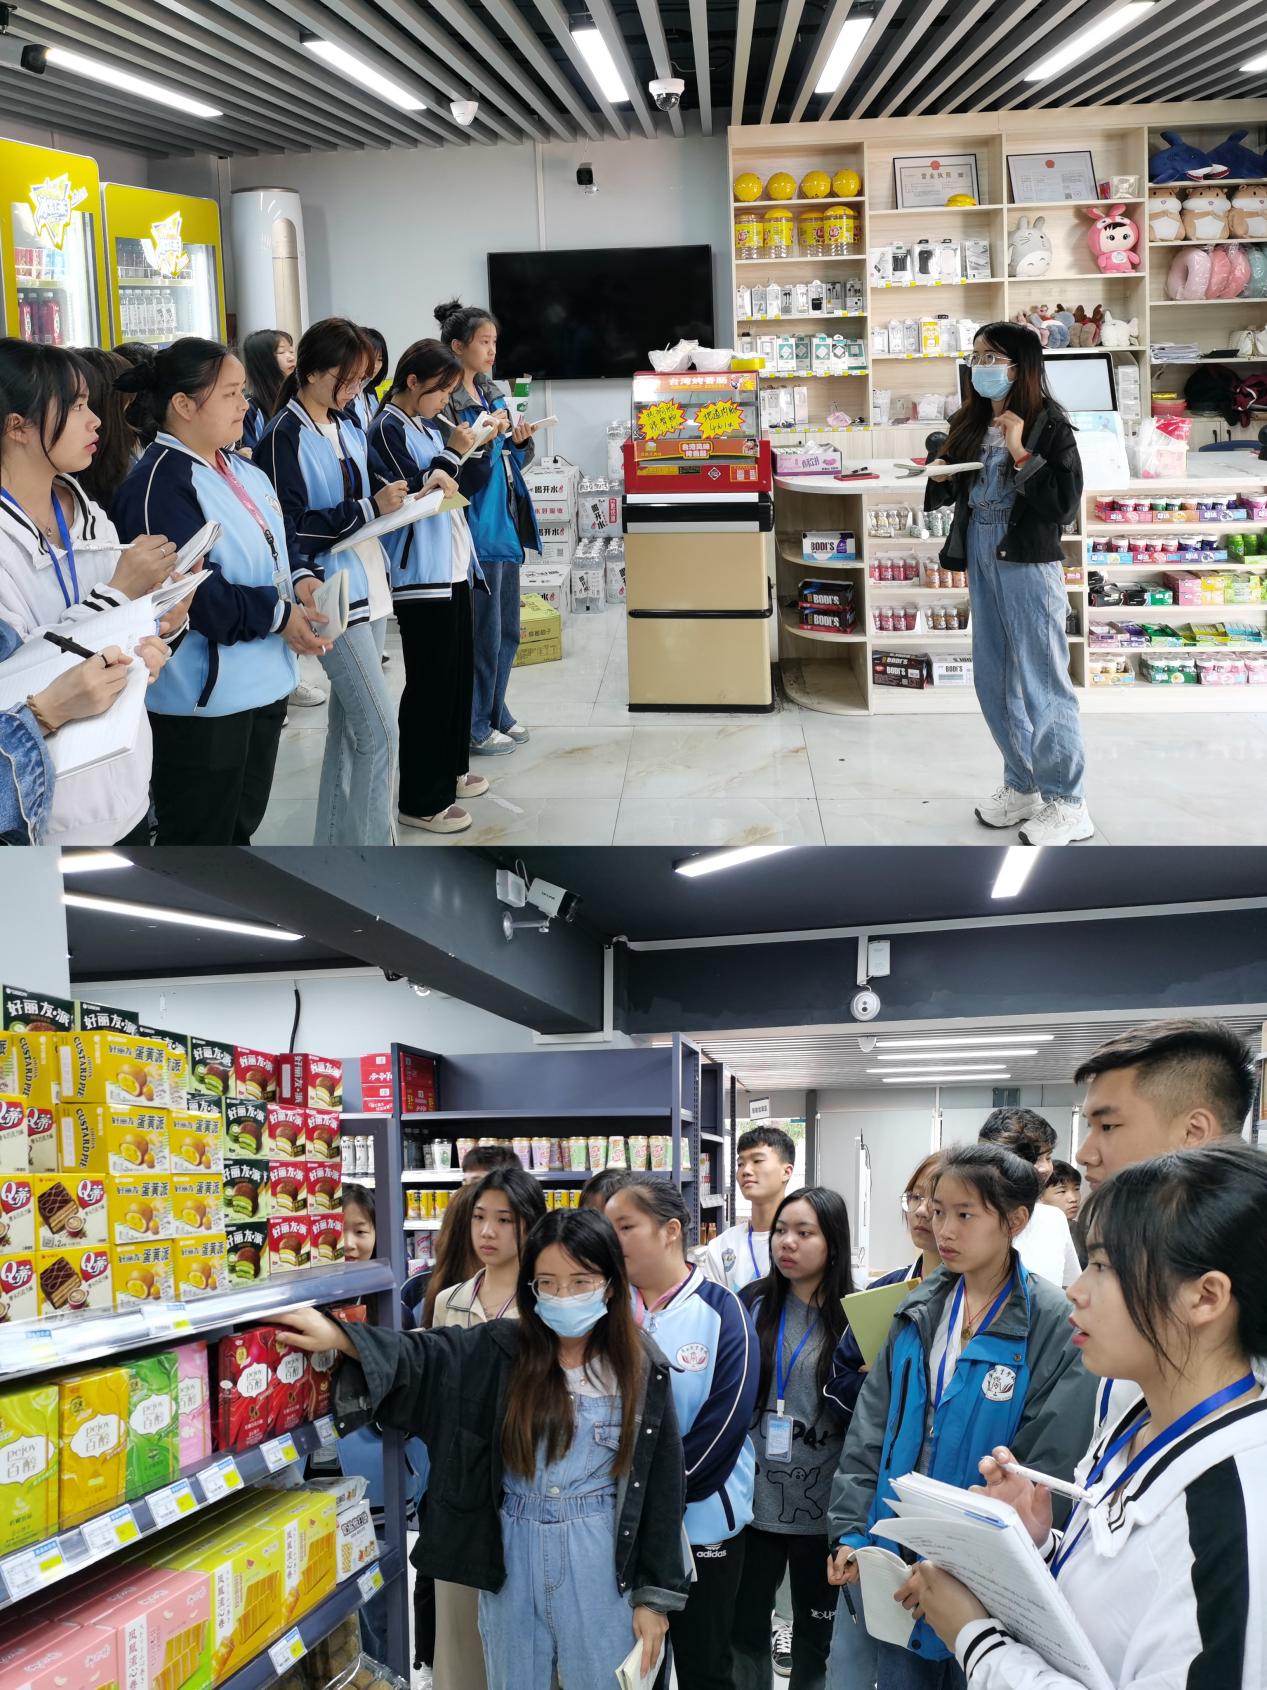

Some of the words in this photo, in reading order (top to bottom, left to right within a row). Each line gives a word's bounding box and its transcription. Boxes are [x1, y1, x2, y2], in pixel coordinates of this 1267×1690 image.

[534, 485, 558, 494] 喝开水
[591, 503, 606, 530] 喝开水
[810, 541, 835, 552] BODI'S
[813, 594, 840, 605] BODI'S
[813, 614, 840, 627] BODI'S
[6, 999, 70, 1028] 好丽友·派
[19, 1037, 33, 1083] CUSTARD
[73, 1036, 87, 1083] CUSTARD
[134, 1045, 165, 1063] 蛋黄派
[193, 1046, 232, 1067] 好丽友·派
[239, 1054, 273, 1073] 好丽友·派
[22, 1083, 32, 1097] PIE
[77, 1083, 86, 1099] PIE
[136, 1115, 165, 1130] 蛋黄派
[227, 1105, 265, 1123] 好丽友·派
[269, 1111, 303, 1128] 好丽友·派
[307, 1114, 338, 1131] 好丽友·派
[75, 1107, 90, 1152] CUSTARD
[195, 1119, 219, 1133] 蛋黄派
[79, 1152, 89, 1169] PIE
[270, 1166, 304, 1182] 好丽友·派
[309, 1166, 340, 1182] 好丽友·派
[141, 1182, 169, 1197] 蛋黄派
[196, 1181, 220, 1195] 蛋黄派
[272, 1220, 308, 1239] 好丽友·派
[143, 1246, 170, 1264] 蛋黄派
[201, 1242, 225, 1256] 蛋黄派
[86, 1434, 110, 1453] 百醇
[7, 1457, 37, 1479] 百醇
[696, 1549, 727, 1558] adidas
